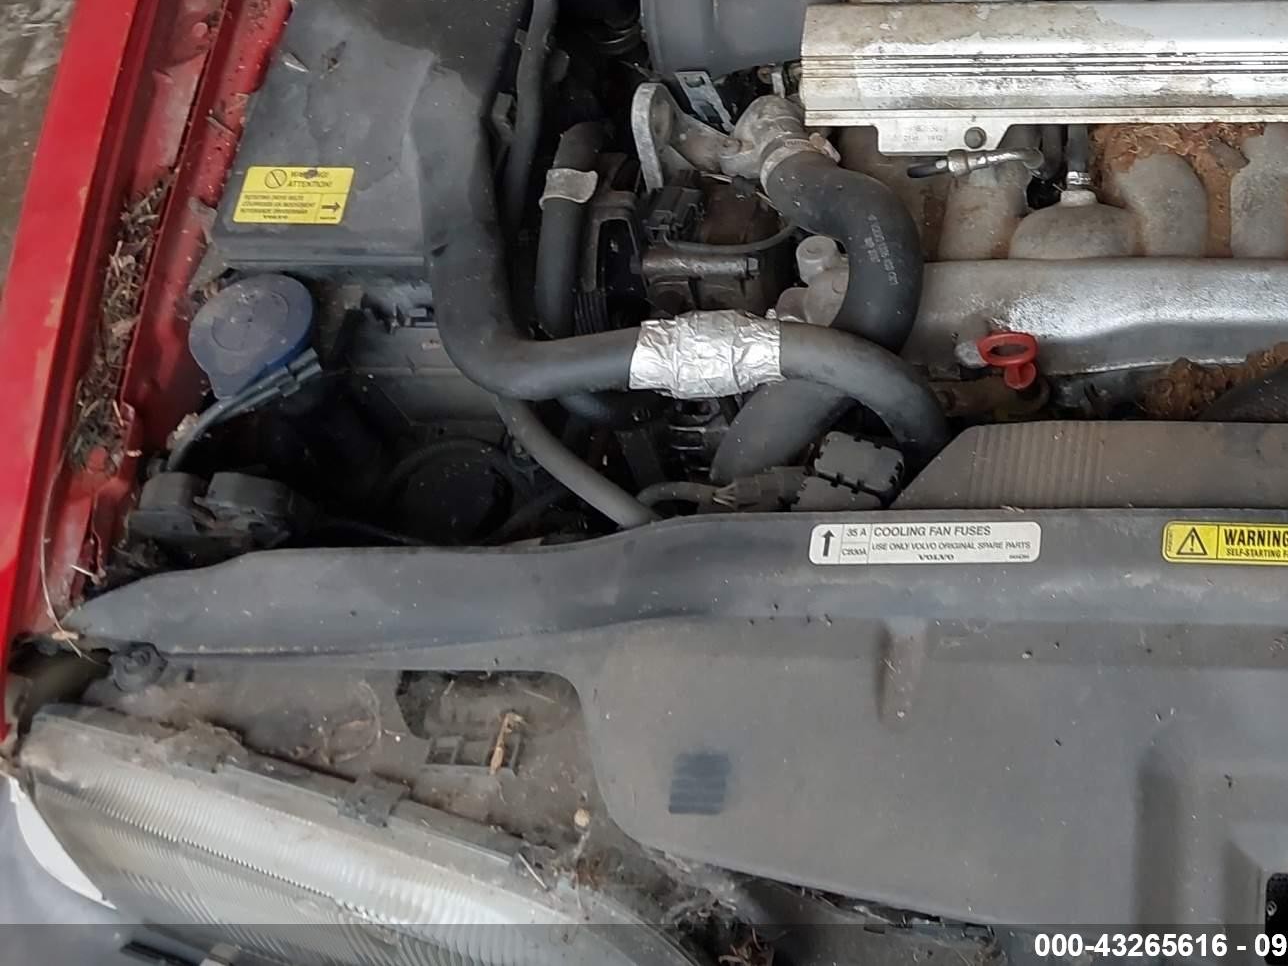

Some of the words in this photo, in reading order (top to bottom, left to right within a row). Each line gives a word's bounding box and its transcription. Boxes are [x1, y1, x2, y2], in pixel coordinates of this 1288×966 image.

[873, 527, 926, 537] COOLING
[929, 526, 950, 536] FAN
[954, 526, 991, 536] FUSES
[872, 542, 887, 550] USE
[889, 542, 909, 550] ONLY
[911, 542, 937, 550] VOLVO
[1005, 541, 1031, 549] PARTS
[1226, 548, 1281, 558] SELF-STARTING
